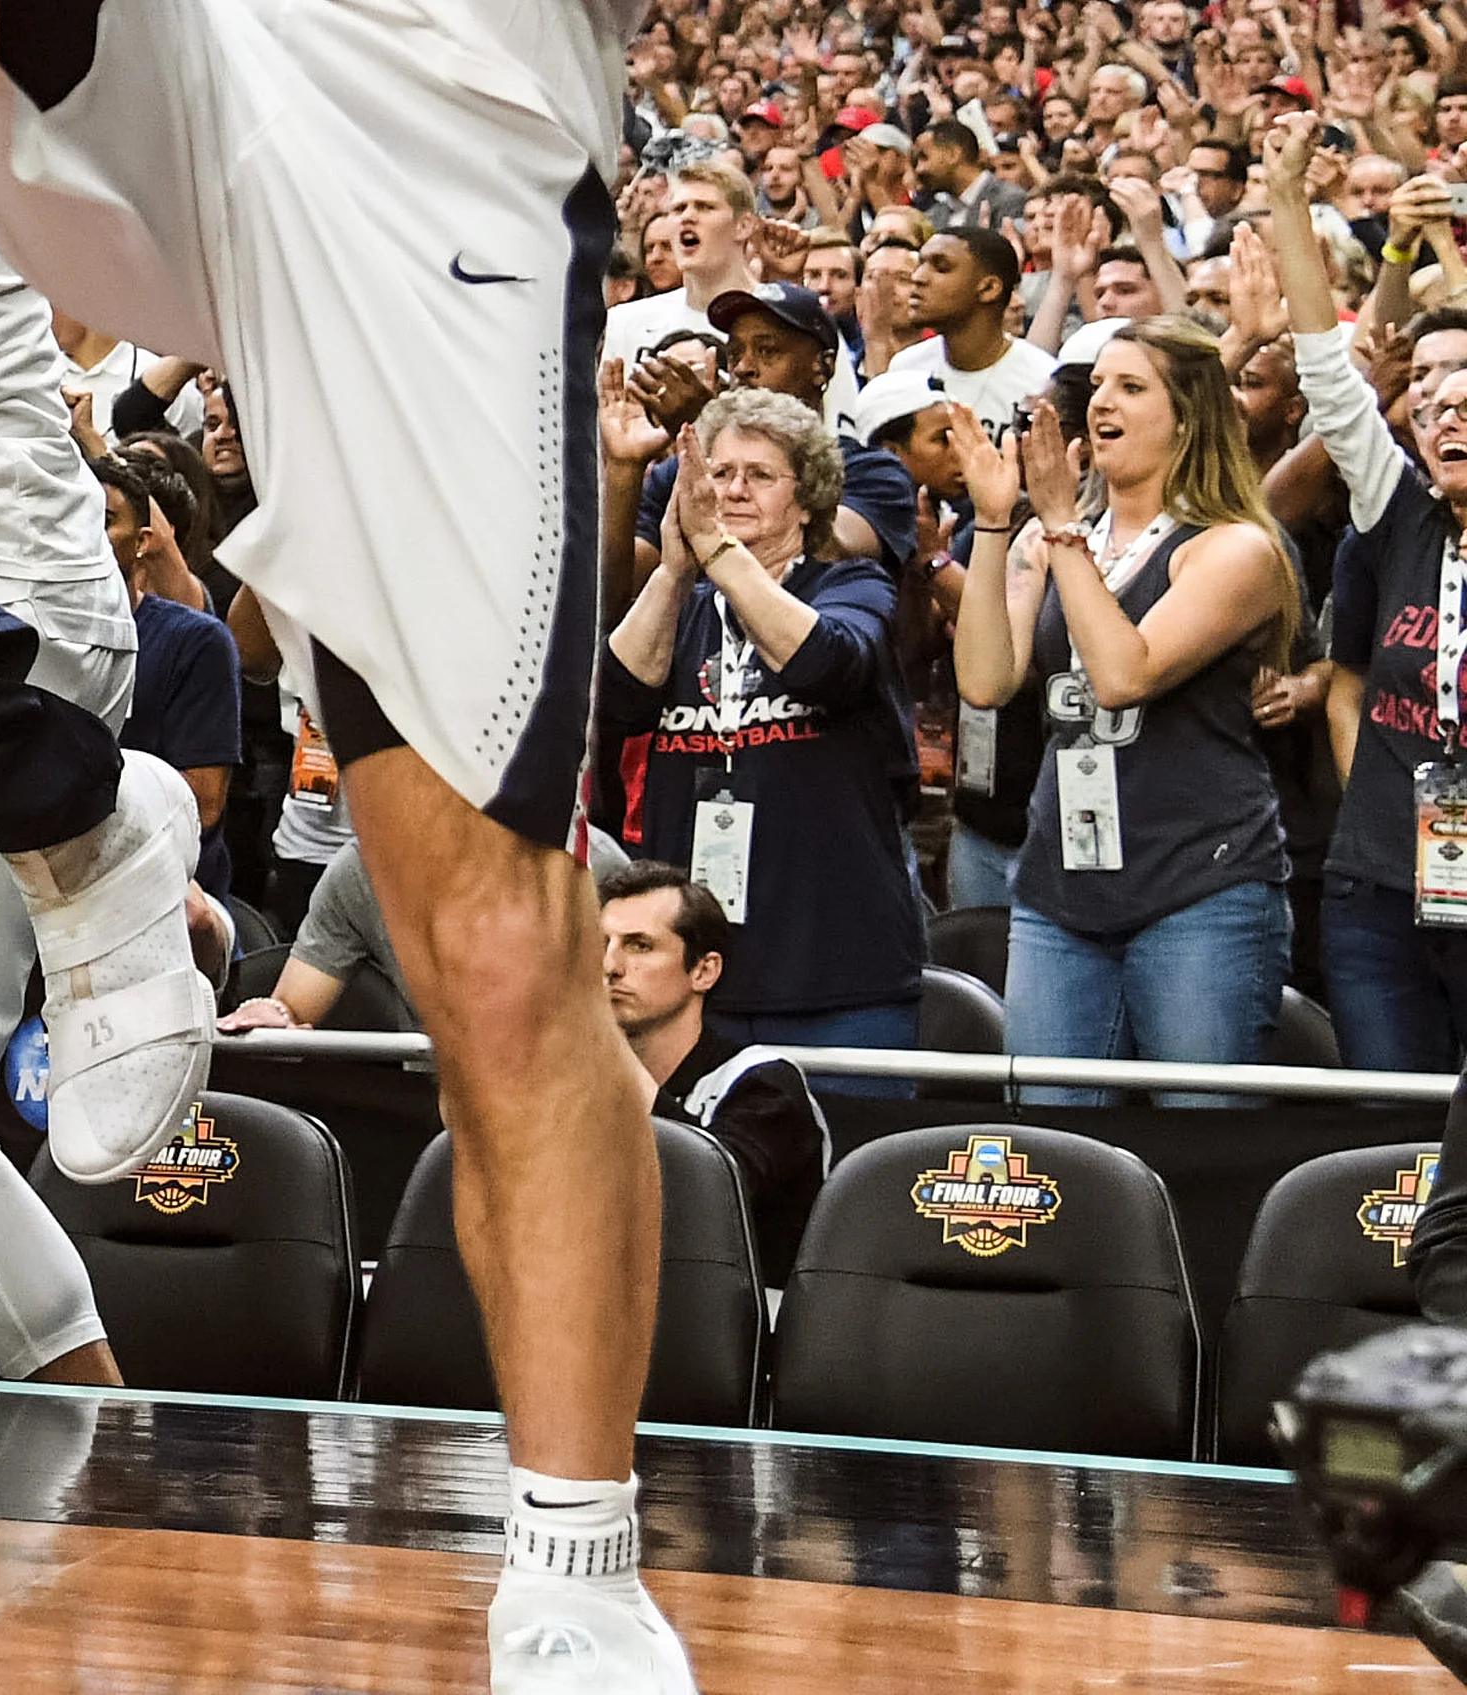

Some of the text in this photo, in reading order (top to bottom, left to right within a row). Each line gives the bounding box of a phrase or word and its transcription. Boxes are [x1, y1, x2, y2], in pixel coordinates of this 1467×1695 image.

[82, 1015, 116, 1049] 25
[176, 1147, 223, 1168] FOUR
[932, 1182, 1041, 1208] FINAL FOUR
